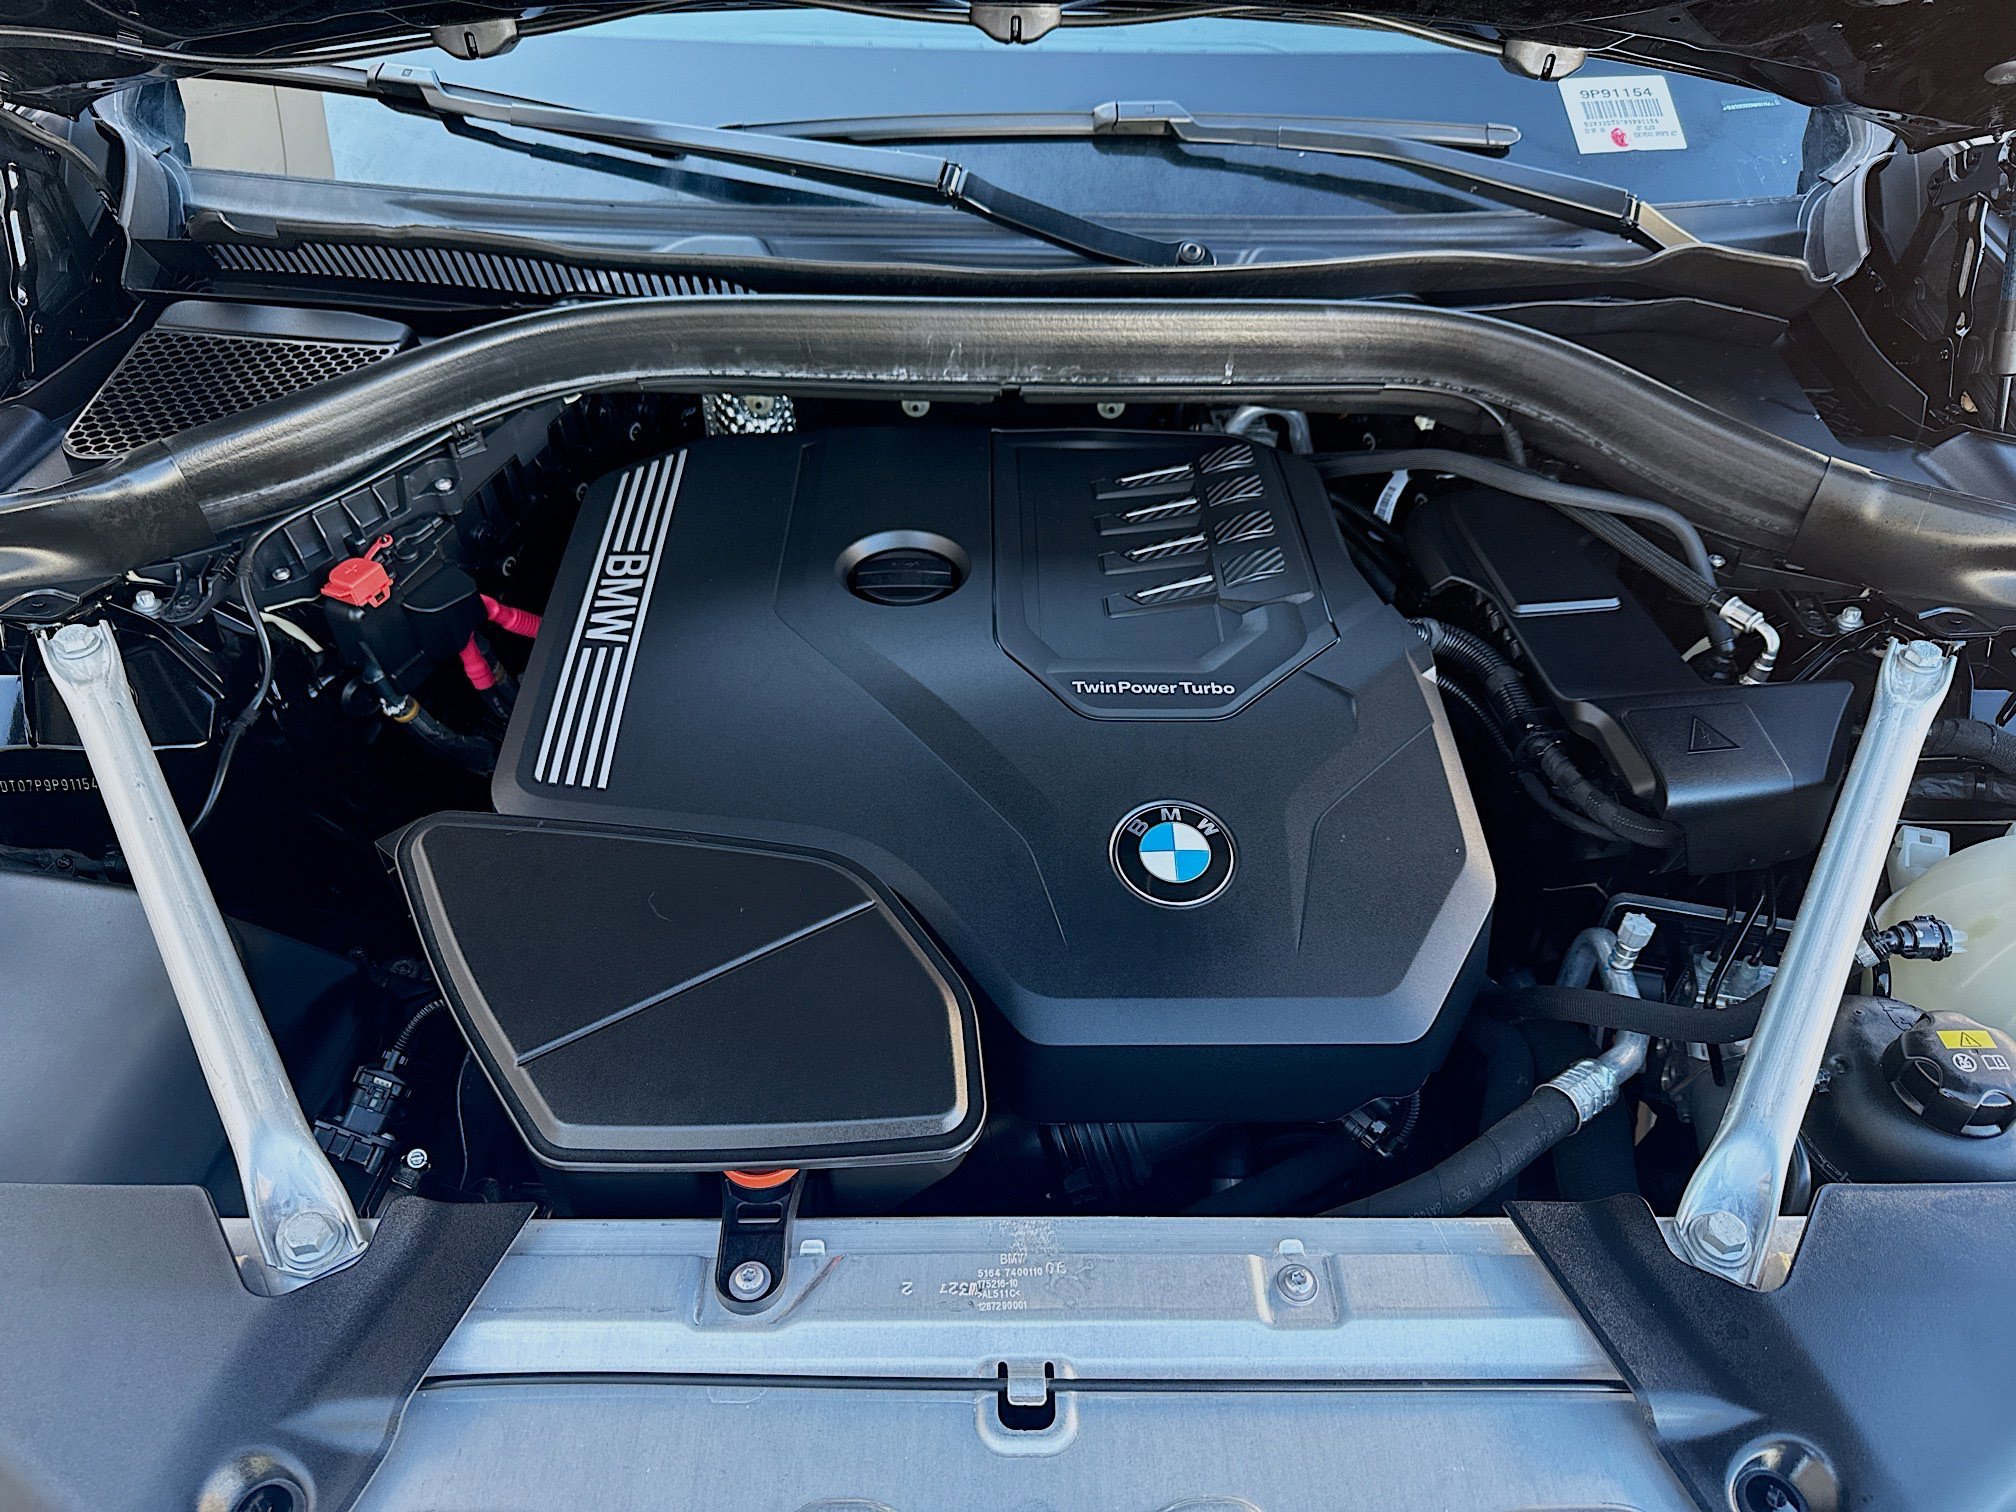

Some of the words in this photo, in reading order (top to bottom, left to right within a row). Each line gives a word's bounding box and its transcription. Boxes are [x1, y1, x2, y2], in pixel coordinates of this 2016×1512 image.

[1580, 87, 1653, 99] 9P91154
[585, 554, 651, 643] BMW
[1072, 680, 1178, 695] TwinPower
[1179, 681, 1236, 695] Turbo
[1127, 807, 1220, 837] BMW
[1000, 1253, 1027, 1265] BMW
[978, 1268, 1001, 1278] 5164
[1005, 1267, 1043, 1277] 7400110
